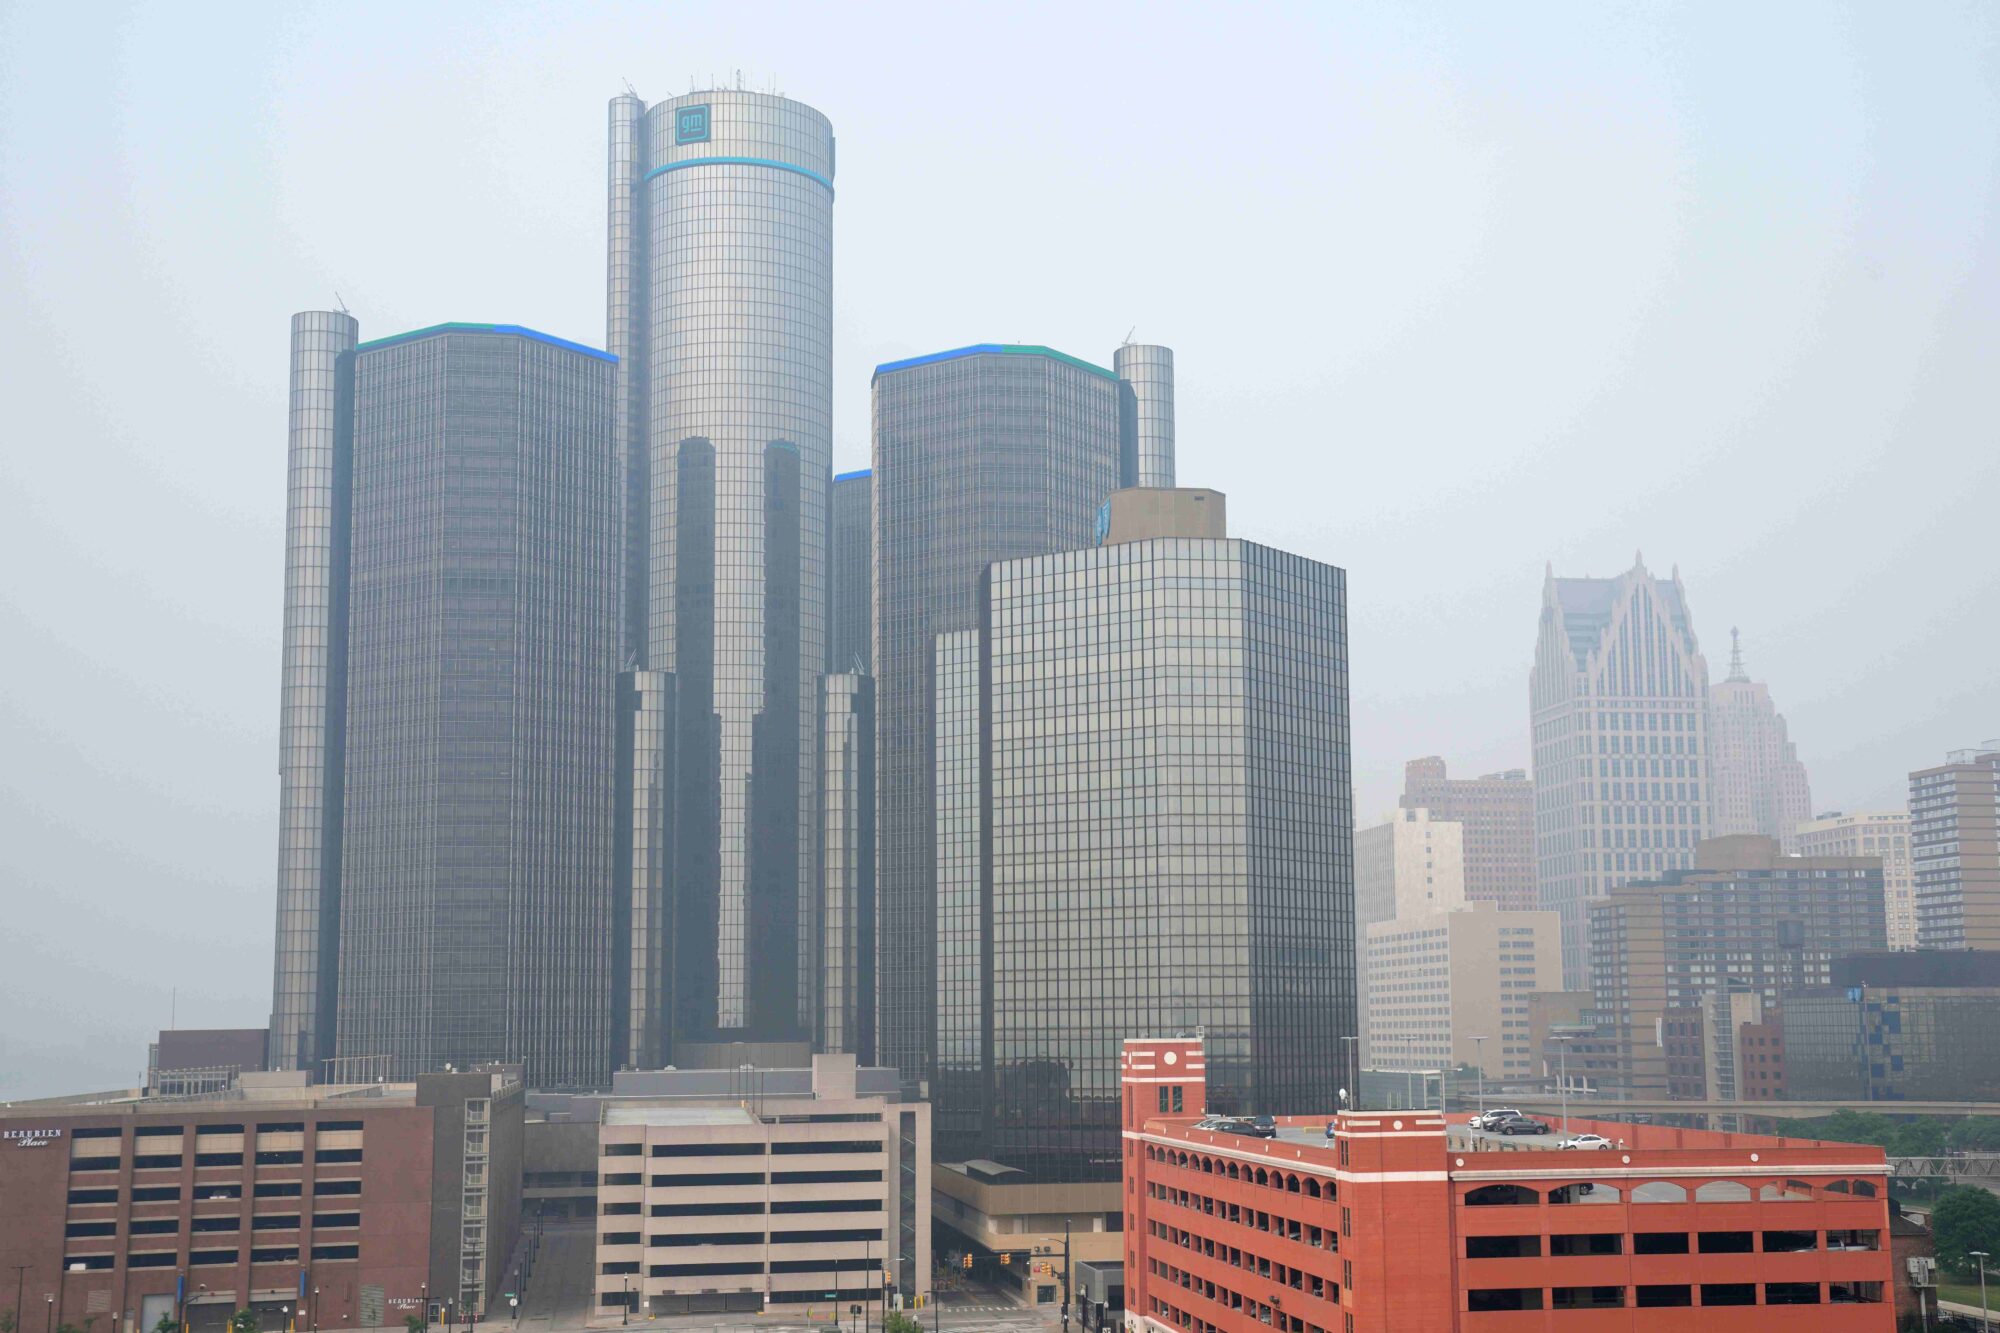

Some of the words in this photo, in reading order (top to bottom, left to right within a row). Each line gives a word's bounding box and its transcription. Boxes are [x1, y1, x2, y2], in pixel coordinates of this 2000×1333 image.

[682, 114, 702, 134] gm
[3, 1130, 61, 1138] BEAUBIEN
[17, 1137, 48, 1146] Place
